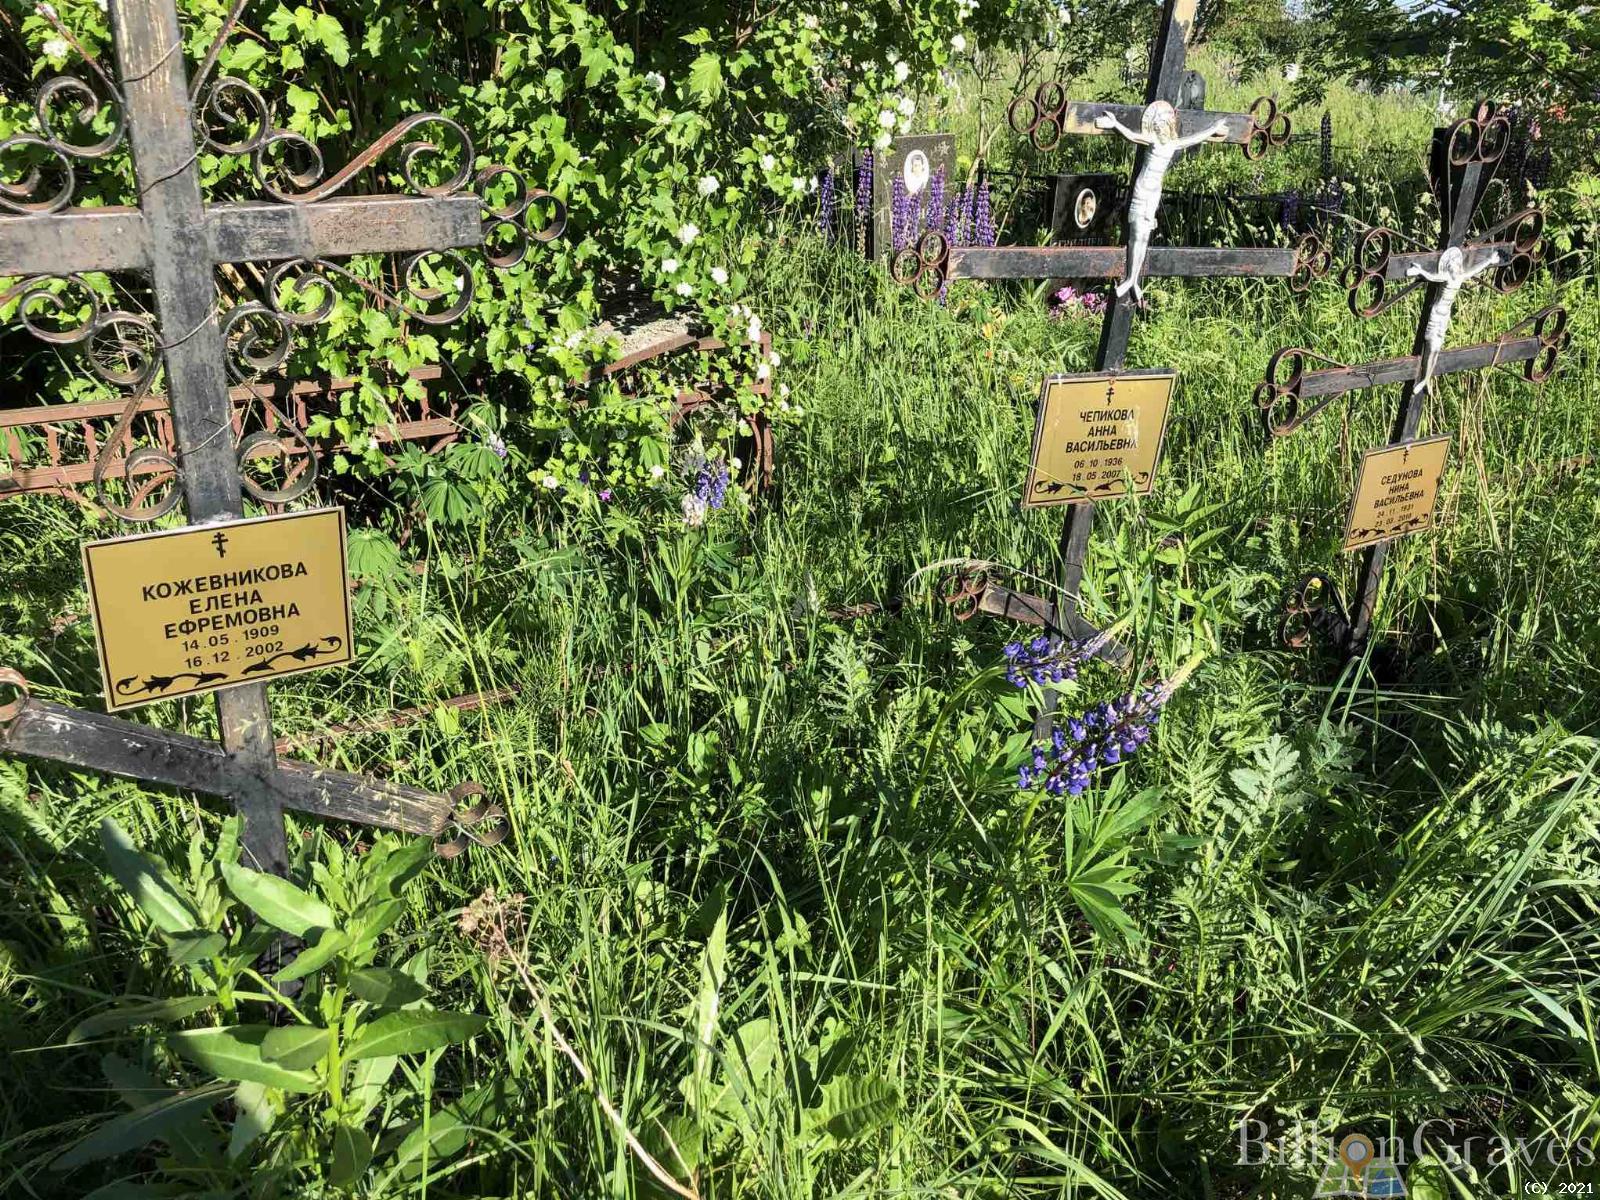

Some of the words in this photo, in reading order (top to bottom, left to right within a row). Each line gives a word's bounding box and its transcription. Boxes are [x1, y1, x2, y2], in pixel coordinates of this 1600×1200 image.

[1079, 409, 1135, 423] ЧЕПИКОВА
[1087, 425, 1117, 438] АННА
[1065, 438, 1138, 454] ВАСИЛЬЕВНА
[1380, 468, 1423, 486] СЕДУНОВА
[1388, 482, 1410, 495] НИНА
[1374, 489, 1424, 509] ВАСИЛЬЕВНА
[142, 561, 308, 602] КОЖЕВНИКОВА
[189, 589, 263, 615] ЕЛЕНА
[164, 602, 301, 639] ЕФРЕМОВНА
